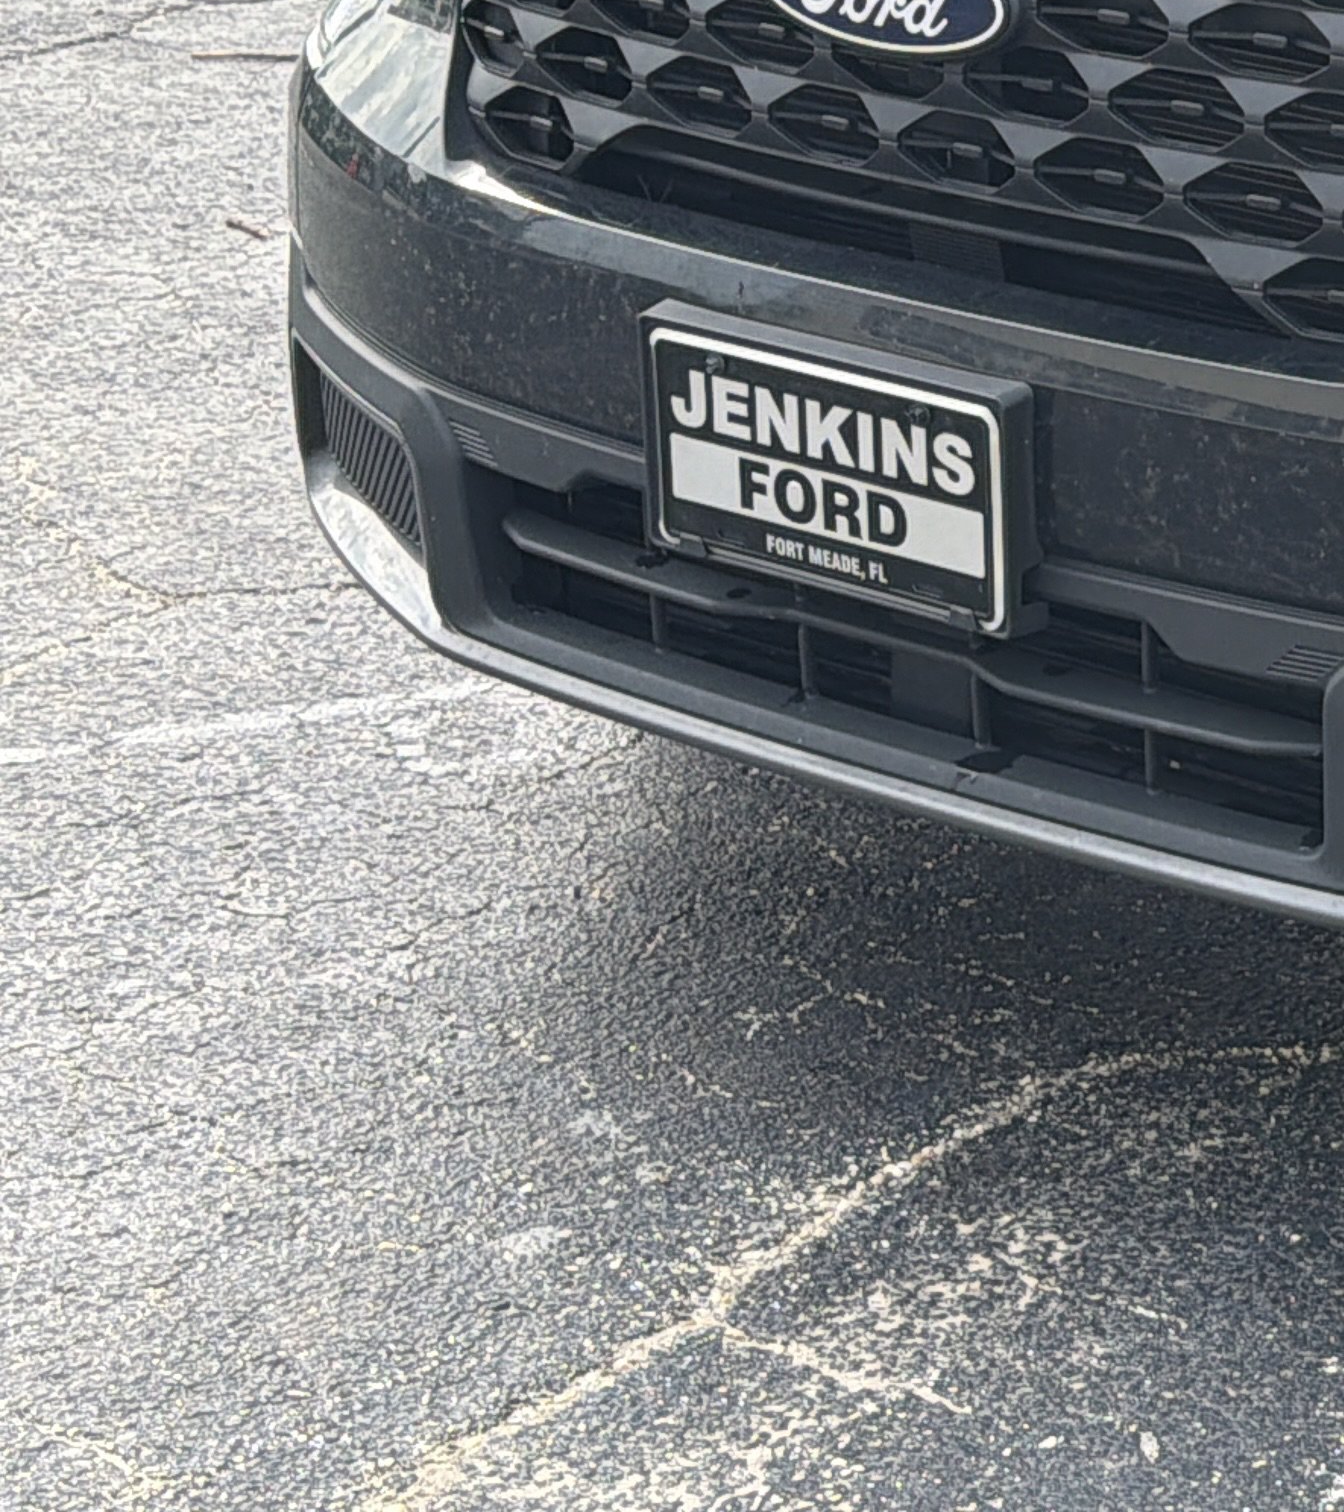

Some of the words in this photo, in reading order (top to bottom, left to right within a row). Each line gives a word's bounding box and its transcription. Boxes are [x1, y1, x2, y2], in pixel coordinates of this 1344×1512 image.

[669, 368, 976, 497] JENKINS
[738, 457, 908, 548] FORD
[765, 533, 806, 563] FORT
[808, 544, 867, 582] MEADE,
[868, 563, 889, 584] FL
